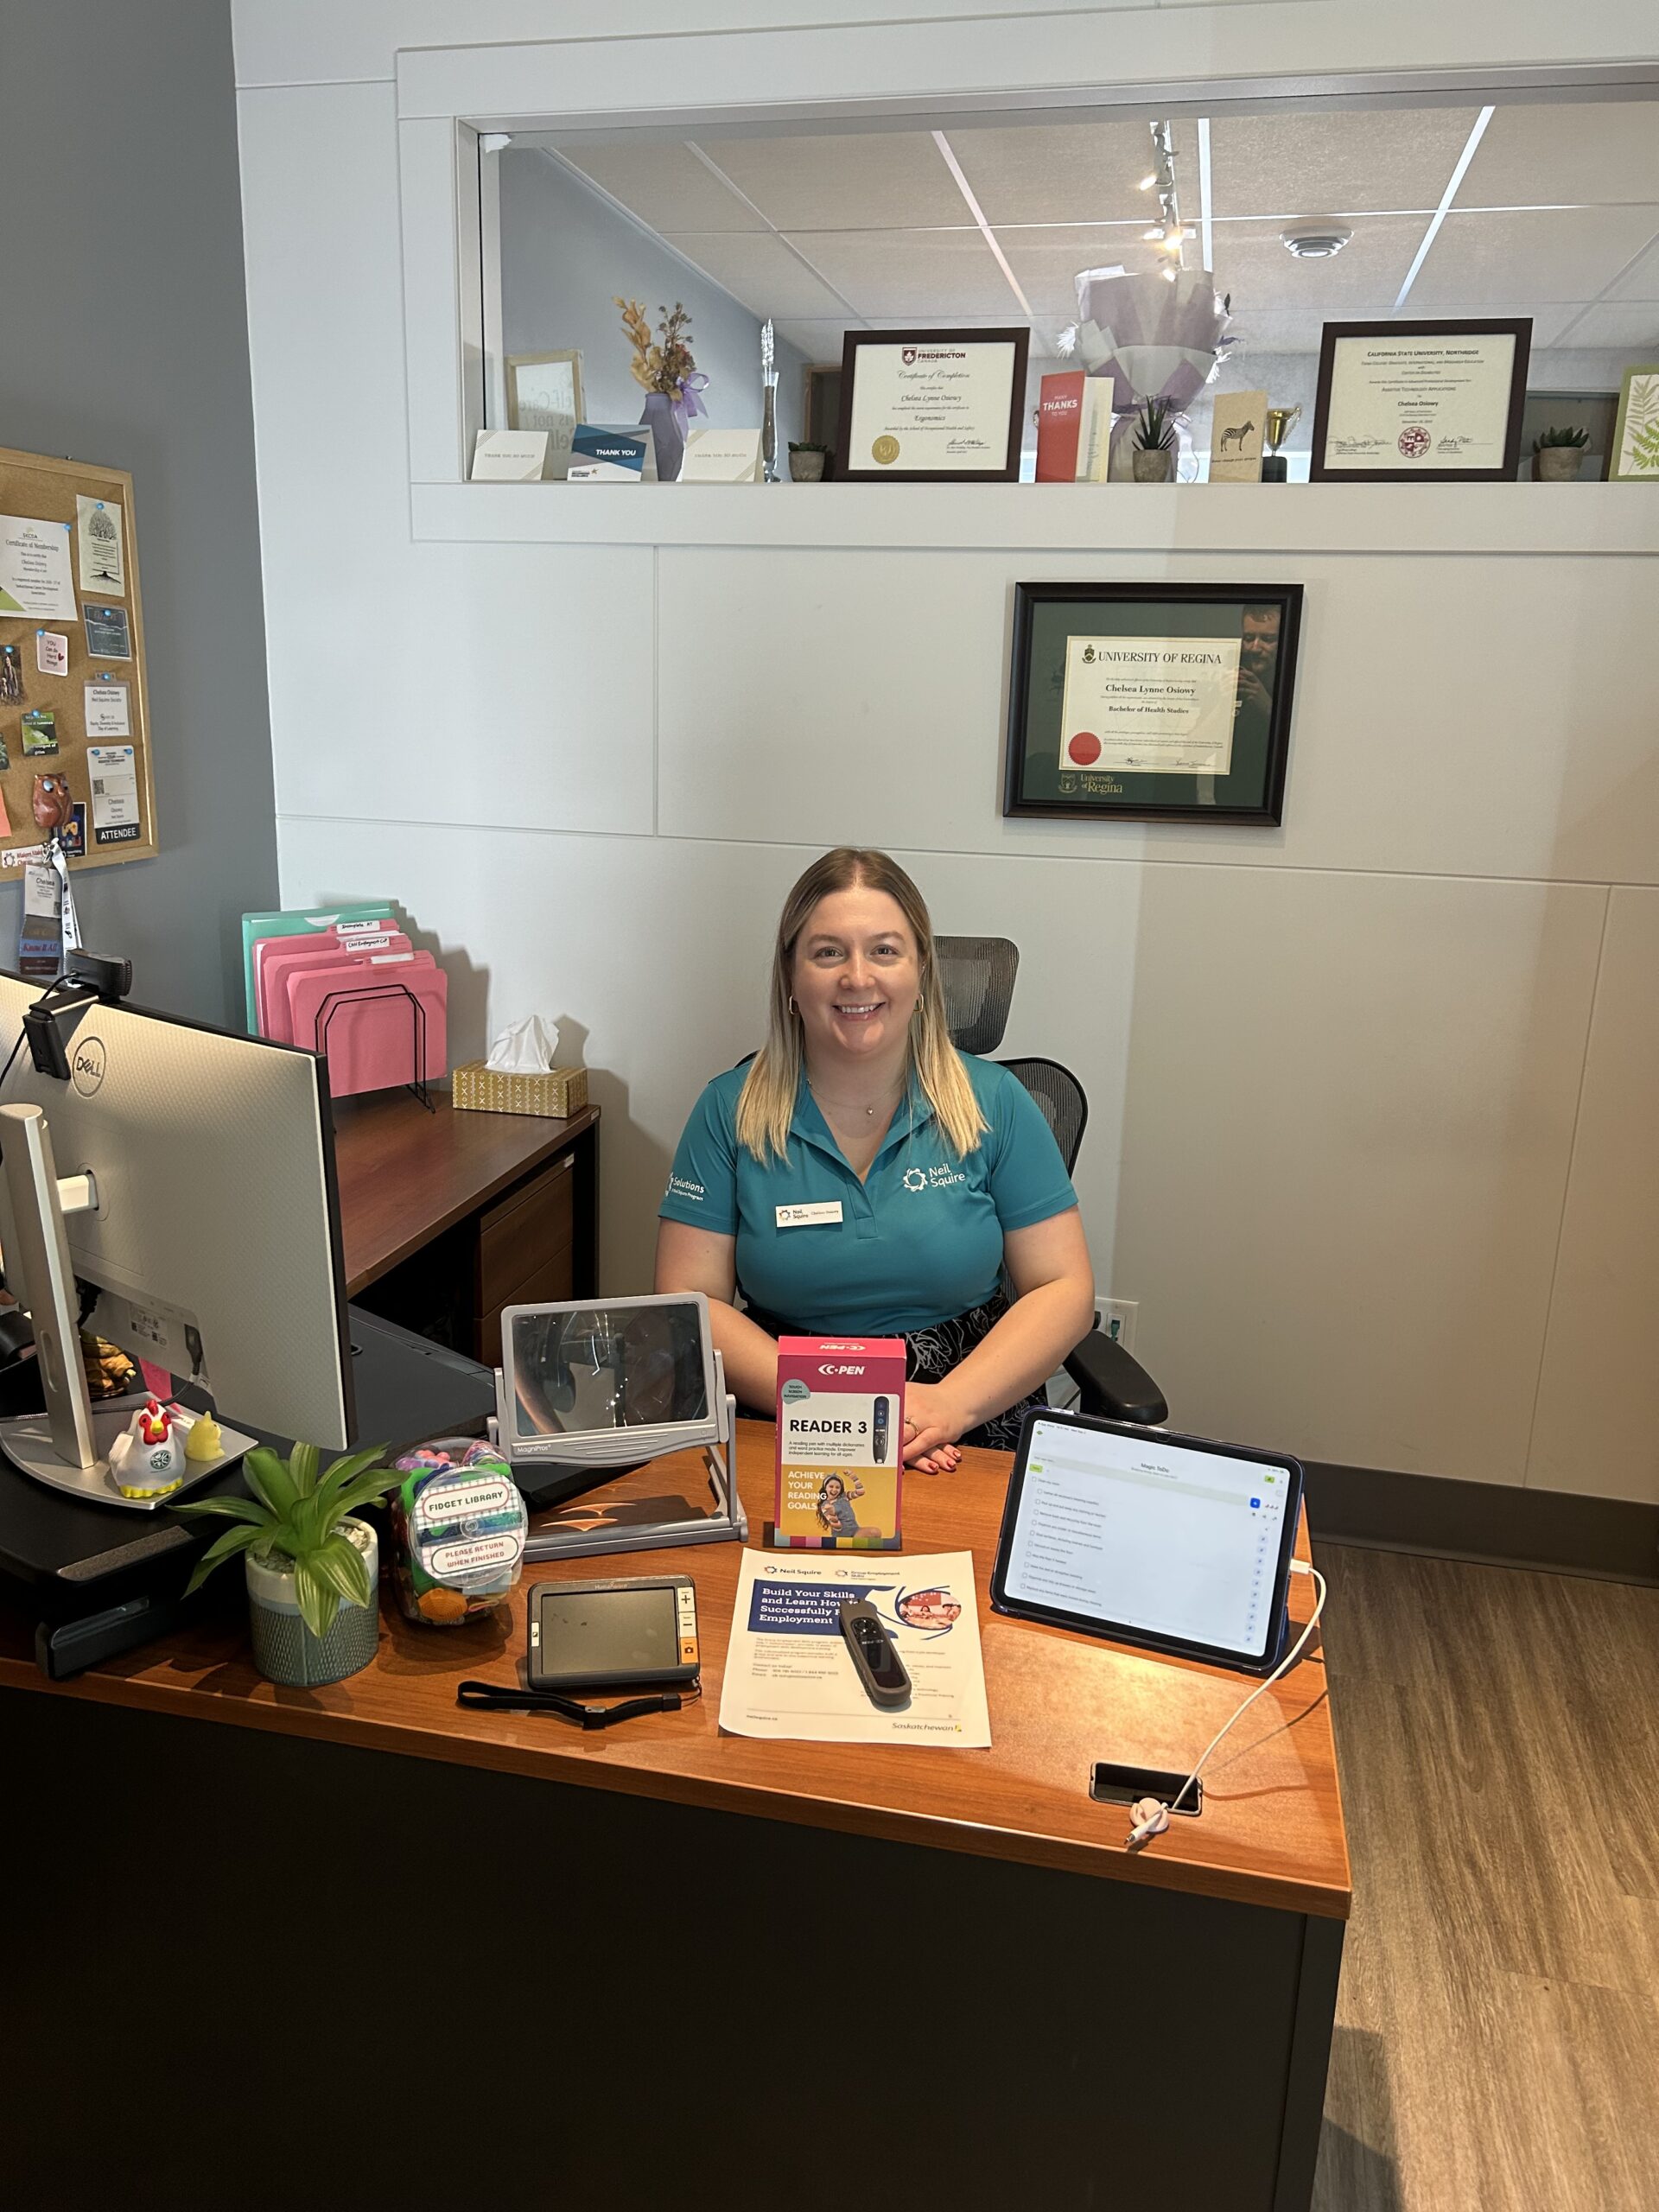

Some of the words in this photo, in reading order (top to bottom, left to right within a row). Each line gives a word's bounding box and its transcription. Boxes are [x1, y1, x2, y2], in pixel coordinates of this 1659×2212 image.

[1043, 399, 1077, 411] THANKS
[1098, 652, 1160, 663] UNIVERSITY
[1163, 652, 1179, 663] OF
[1180, 653, 1222, 664] REGINA
[1105, 683, 1137, 693] Chelsea
[1139, 685, 1165, 696] Lynne
[1166, 686, 1197, 696] Osiowy
[1080, 773, 1115, 783] University
[1087, 782, 1123, 795] Regina
[100, 827, 137, 841] ATTENDEE
[76, 1056, 101, 1077] DELL
[928, 1162, 951, 1178] Neil
[673, 1177, 705, 1193] Solutions
[930, 1173, 966, 1188] Squire
[687, 1192, 704, 1202] Program
[790, 1419, 852, 1433] READER
[857, 1421, 868, 1434] 3
[787, 1471, 825, 1479] ACHIEVE
[788, 1481, 814, 1490] YOUR
[429, 1498, 463, 1512] FIDGET
[465, 1491, 504, 1505] LIBRARY
[787, 1491, 828, 1501] READING
[787, 1502, 817, 1510] GOALS
[445, 1548, 474, 1559] PLEASE
[474, 1541, 505, 1554] RETURN
[447, 1558, 470, 1568] WHEN
[471, 1551, 505, 1564] FINISHED
[762, 1587, 792, 1597] Build
[823, 1591, 855, 1599] Skills
[760, 1605, 832, 1617] Successfully
[759, 1614, 833, 1624] Employment
[891, 1722, 954, 1732] Saskatchewan
